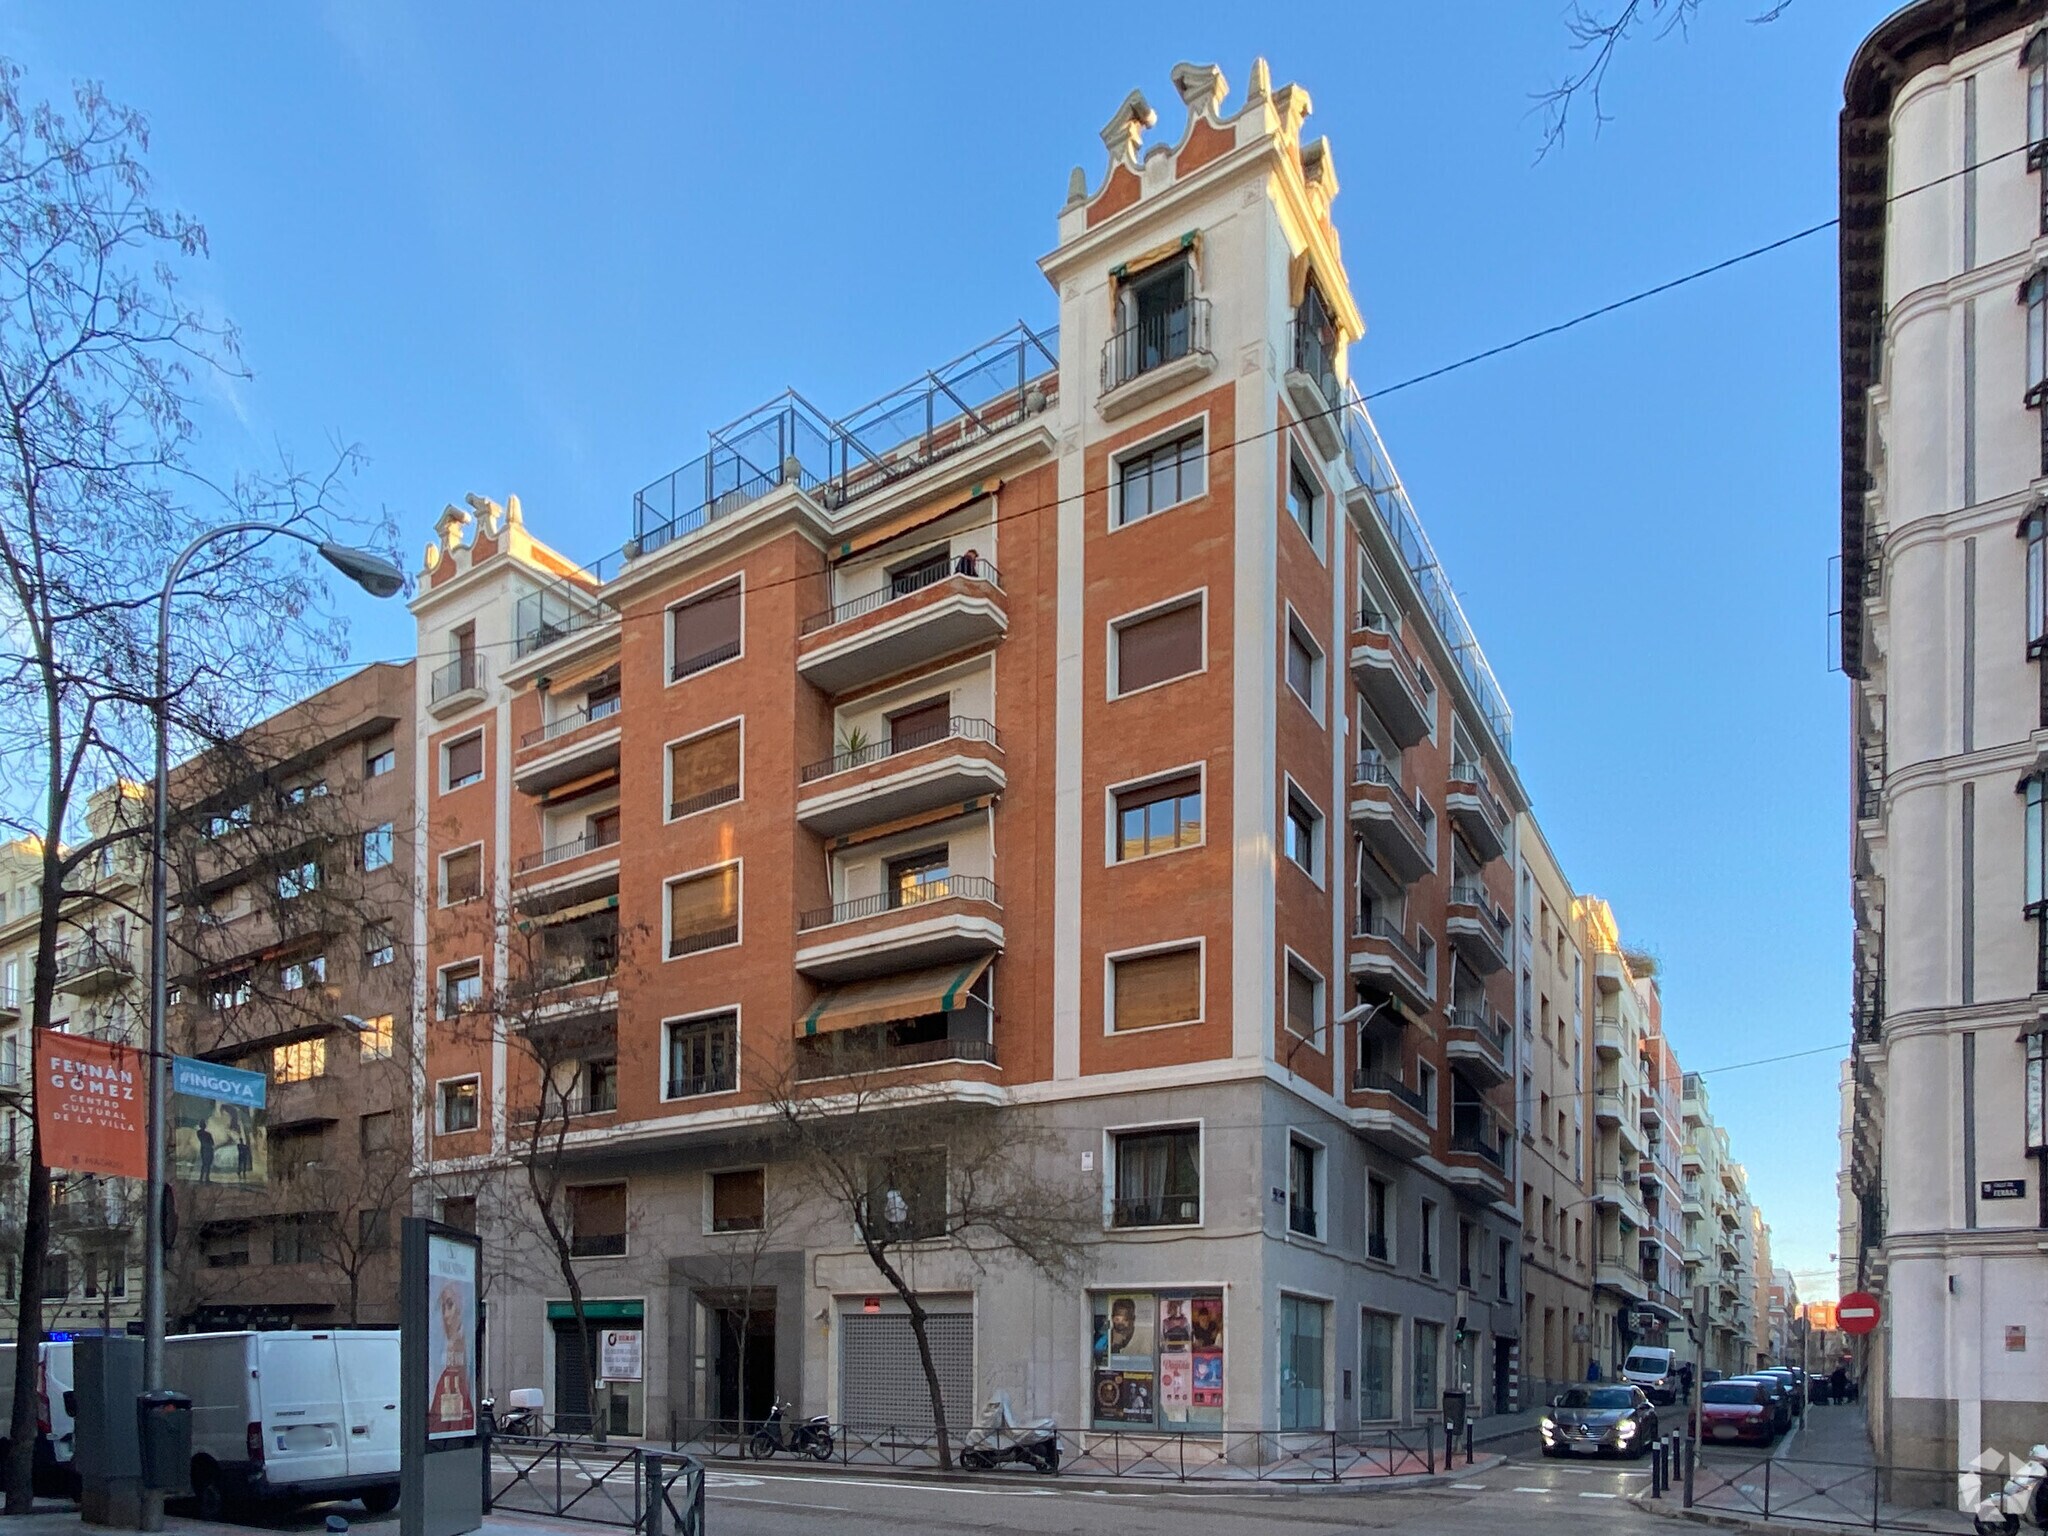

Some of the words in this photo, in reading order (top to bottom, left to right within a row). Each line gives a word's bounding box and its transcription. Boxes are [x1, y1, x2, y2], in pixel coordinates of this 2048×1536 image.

[50, 1057, 132, 1084] FERNÁN
[180, 1071, 254, 1098] #INGOYA
[70, 1094, 119, 1109] CENTRO
[62, 1103, 126, 1120] CULTURAL
[53, 1112, 69, 1121] DE
[77, 1115, 93, 1125] LA
[100, 1119, 134, 1131] VILLA
